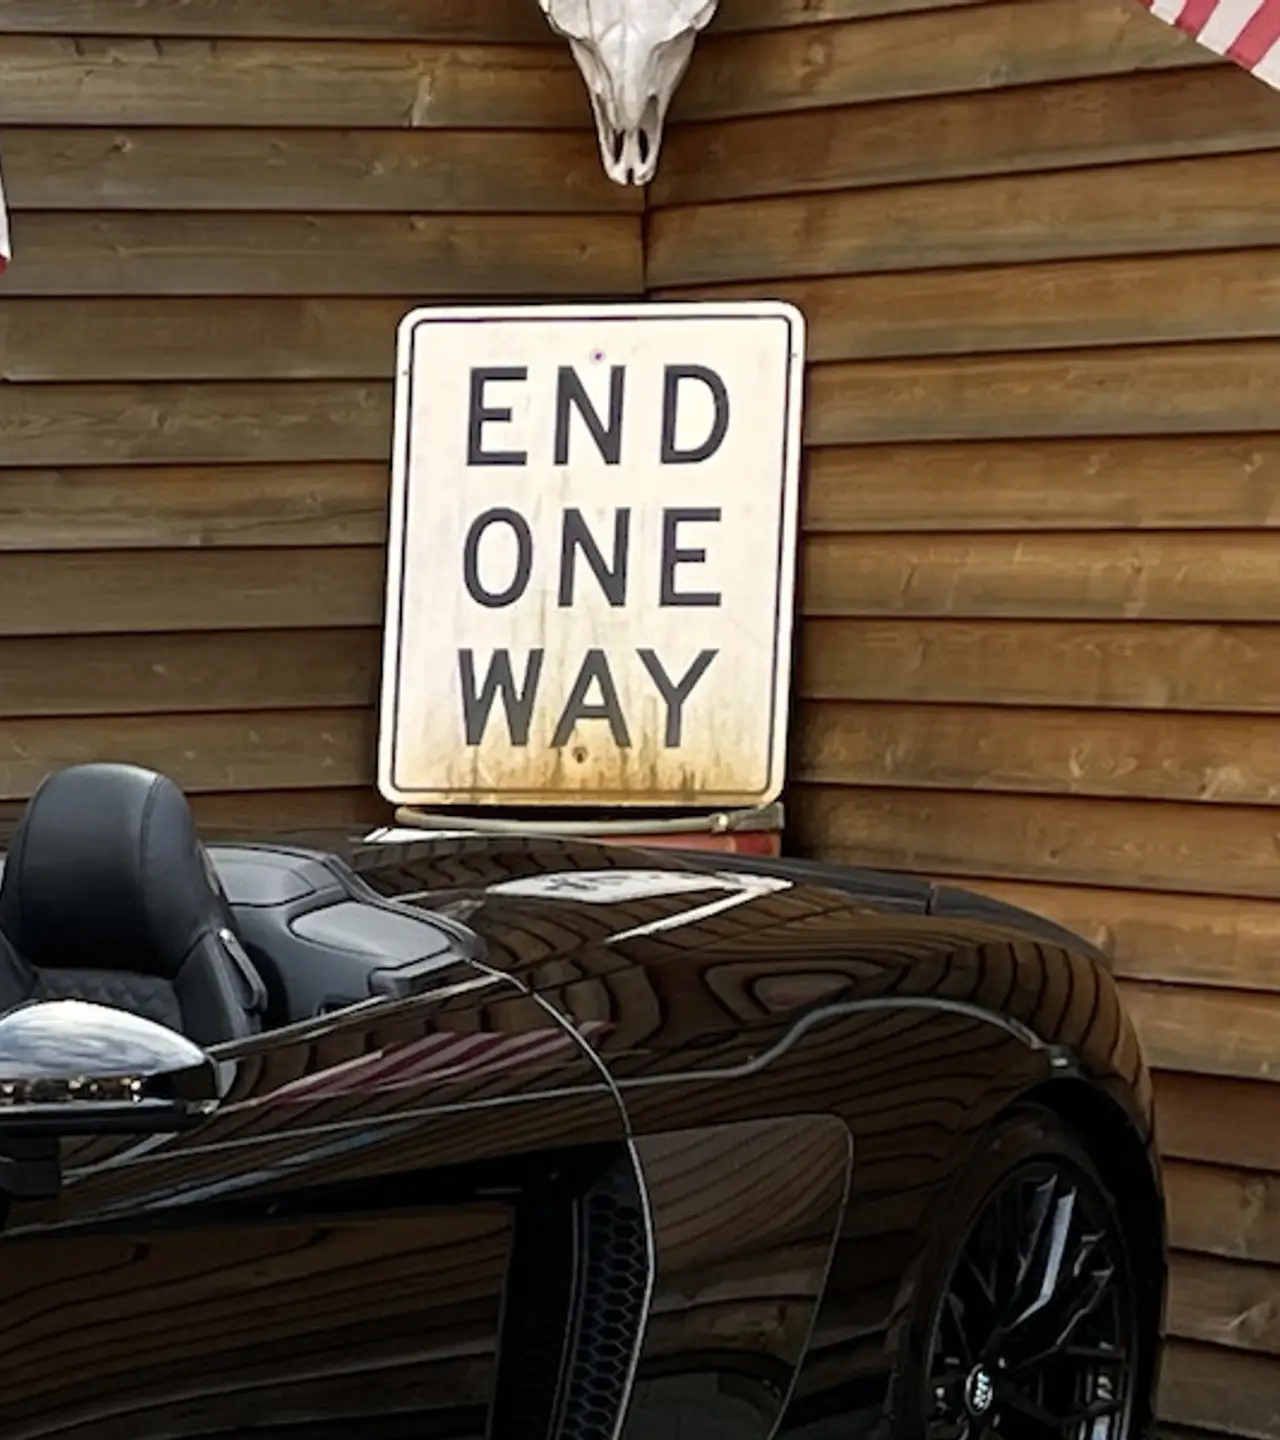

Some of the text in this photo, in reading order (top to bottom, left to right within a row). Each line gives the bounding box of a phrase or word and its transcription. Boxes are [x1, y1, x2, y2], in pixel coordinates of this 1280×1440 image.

[465, 364, 731, 467] END
[462, 506, 723, 608] ONE
[457, 648, 720, 749] WAY
